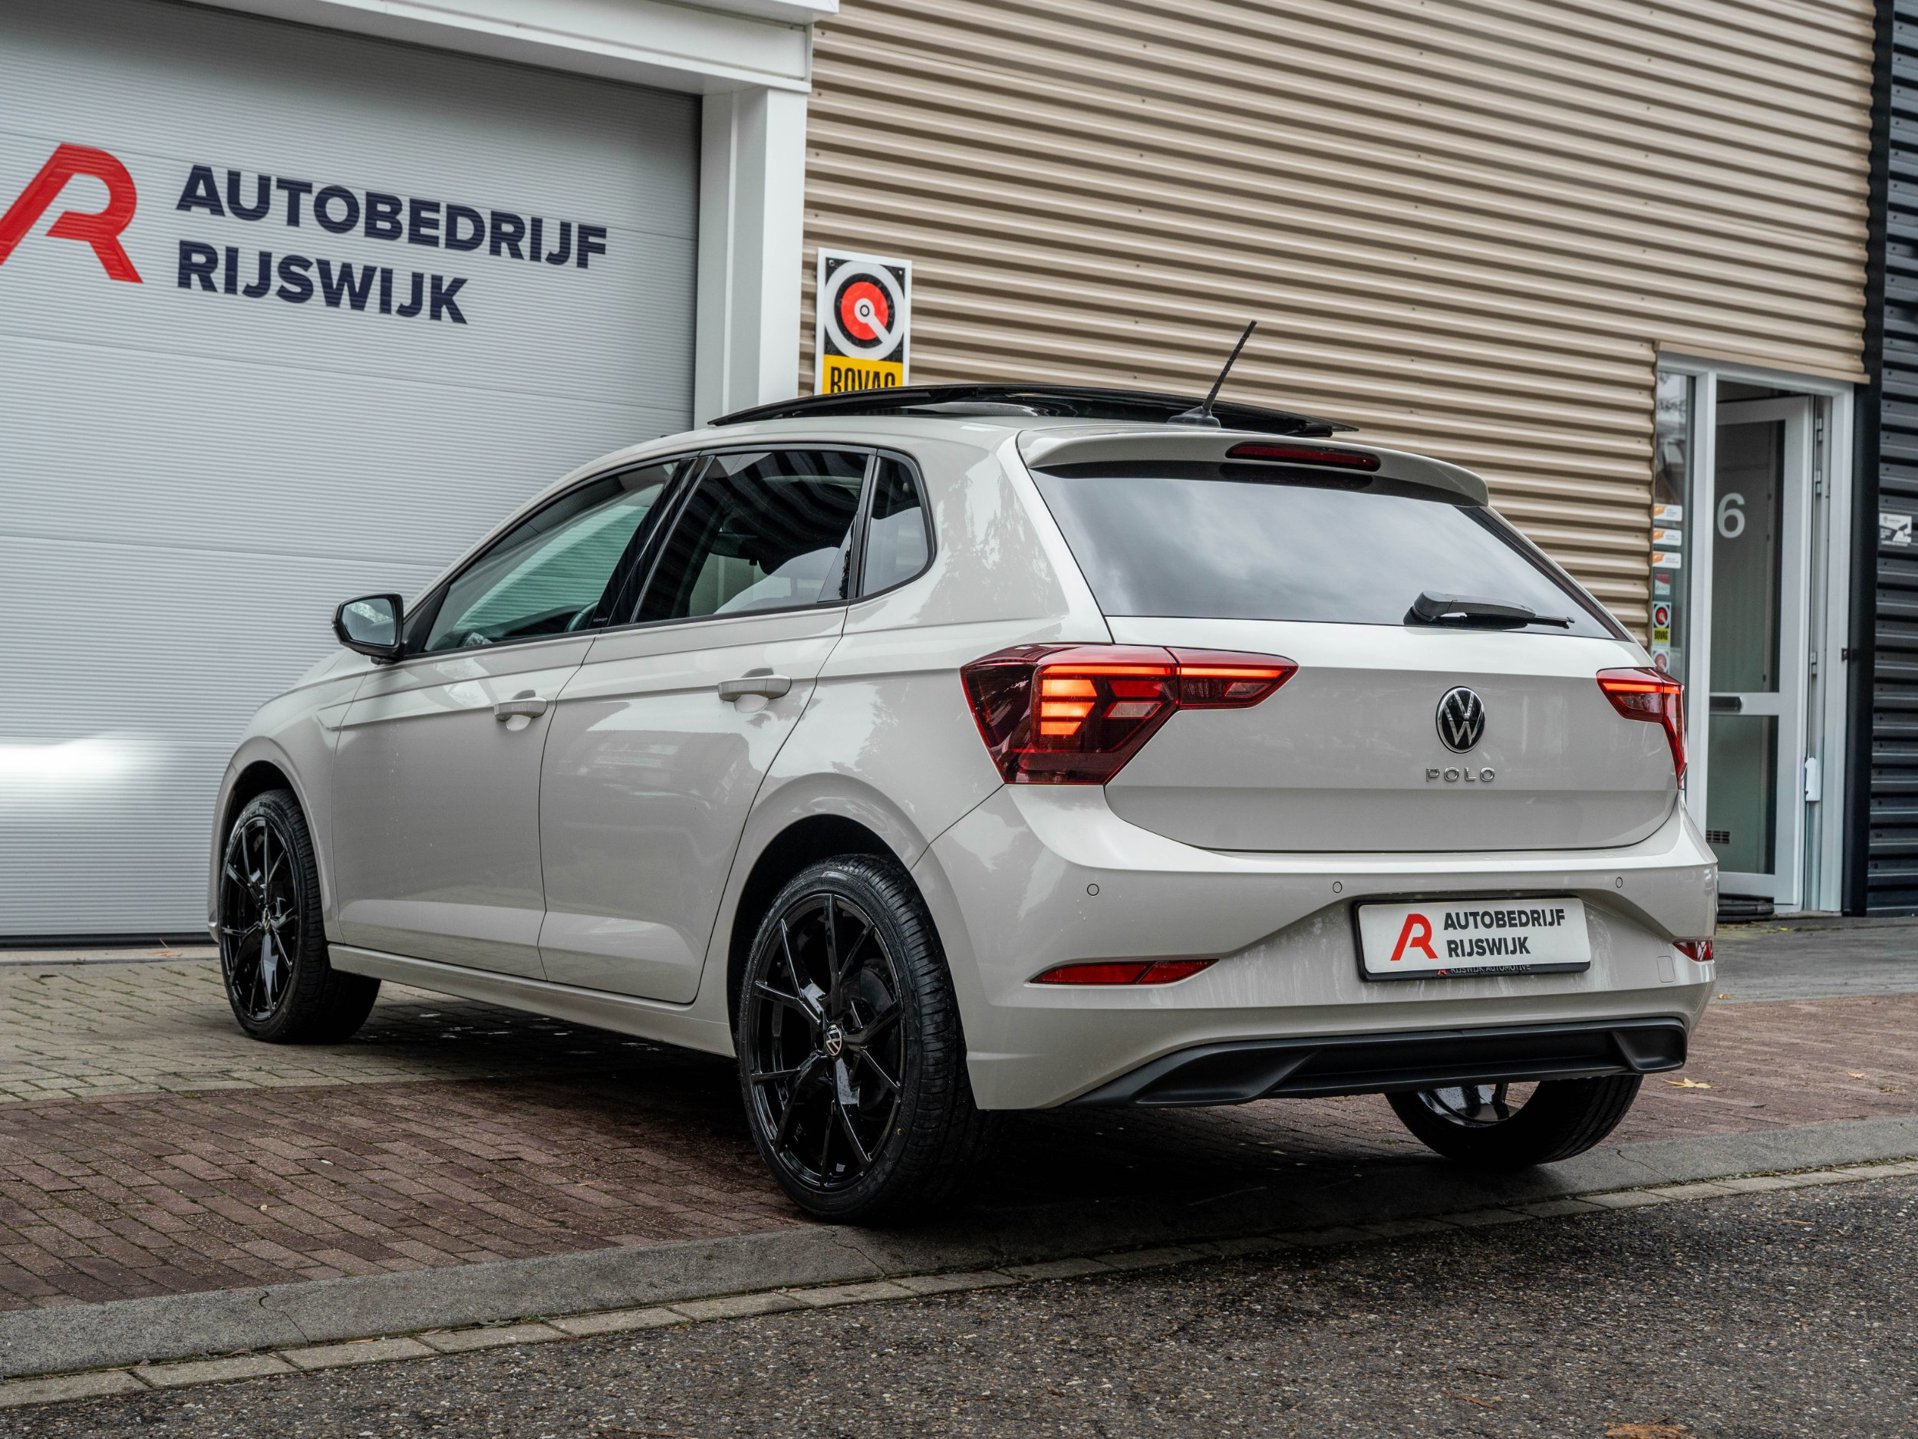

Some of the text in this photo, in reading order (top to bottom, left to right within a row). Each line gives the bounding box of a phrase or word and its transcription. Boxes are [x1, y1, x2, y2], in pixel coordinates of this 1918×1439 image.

[175, 164, 607, 270] AUTOBEDRIJF
[176, 239, 469, 325] RIJSWIJK
[1716, 492, 1746, 539] 6
[1426, 767, 1495, 782] POLO
[1443, 908, 1566, 931] AUTOBEDRIJF
[1446, 936, 1531, 958] RIJSWIJK
